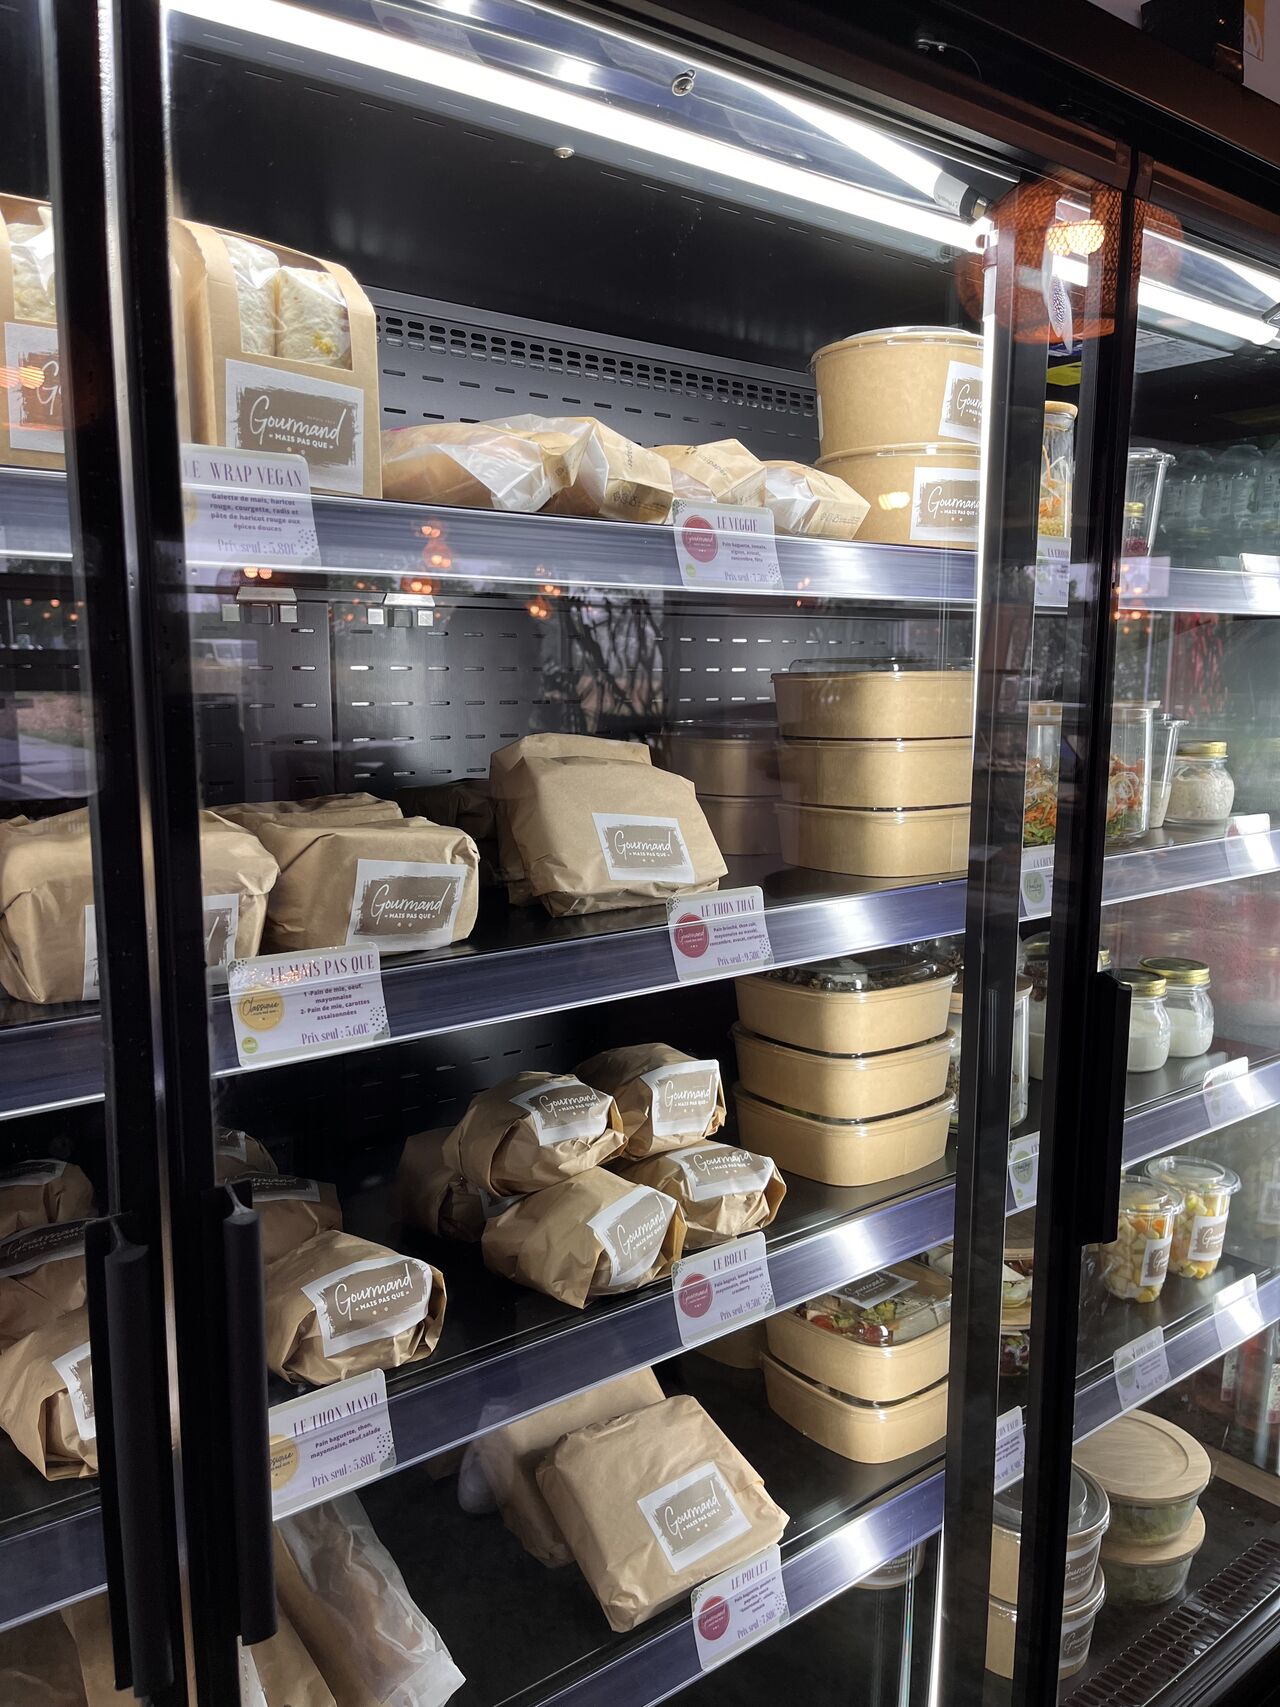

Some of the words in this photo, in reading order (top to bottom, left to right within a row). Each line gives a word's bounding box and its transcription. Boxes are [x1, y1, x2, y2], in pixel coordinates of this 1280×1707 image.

[250, 395, 347, 446] Gourmand
[275, 433, 295, 443] MAIS
[297, 437, 310, 446] PAS
[312, 440, 328, 449] QUE
[210, 462, 252, 483] WRAP
[257, 467, 303, 487] VEGAN
[210, 503, 233, 511] rouge,
[235, 505, 272, 514] courgette,
[212, 493, 239, 501] Galette
[271, 498, 295, 506] haricot
[239, 514, 265, 522] haricot
[717, 516, 727, 529] LE
[729, 516, 758, 532] VEGGIE
[241, 541, 261, 553] seul
[614, 830, 673, 861] Gourmand
[371, 882, 452, 926] Gourmand
[701, 904, 710, 918] LE
[712, 901, 734, 916] THON
[737, 896, 755, 912] THAÏ
[289, 960, 321, 978] MAIS
[324, 957, 348, 975] PAS
[351, 954, 375, 974] QUE
[315, 994, 352, 1004] mayonnaise
[345, 1000, 370, 1008] carottes
[317, 1010, 357, 1021] assaisonnées
[301, 1032, 320, 1044] Prix
[320, 1027, 339, 1041] seul
[539, 1086, 601, 1118] Gourmand
[664, 1074, 712, 1113] Gourmand
[693, 1151, 753, 1176] Gourmand
[617, 1195, 667, 1260] Gourmand
[713, 1257, 723, 1271] LE
[335, 1262, 413, 1321] Gourmand
[359, 1301, 378, 1310] MAIS
[378, 1296, 391, 1304] PAS
[391, 1291, 405, 1300] QUE
[293, 1419, 306, 1438] LE
[308, 1406, 342, 1431] THON
[346, 1392, 378, 1416] MAYO
[315, 1440, 329, 1448] Pain
[329, 1429, 357, 1443] baguette,
[310, 1442, 348, 1459] mayonnaise,
[312, 1473, 329, 1488] Prix
[330, 1463, 347, 1480] seul
[664, 1479, 721, 1540] Gourmand
[686, 1520, 698, 1529] MAIS
[707, 1509, 717, 1517] QUE
[731, 1577, 740, 1590] LE
[742, 1560, 769, 1585] POULET
